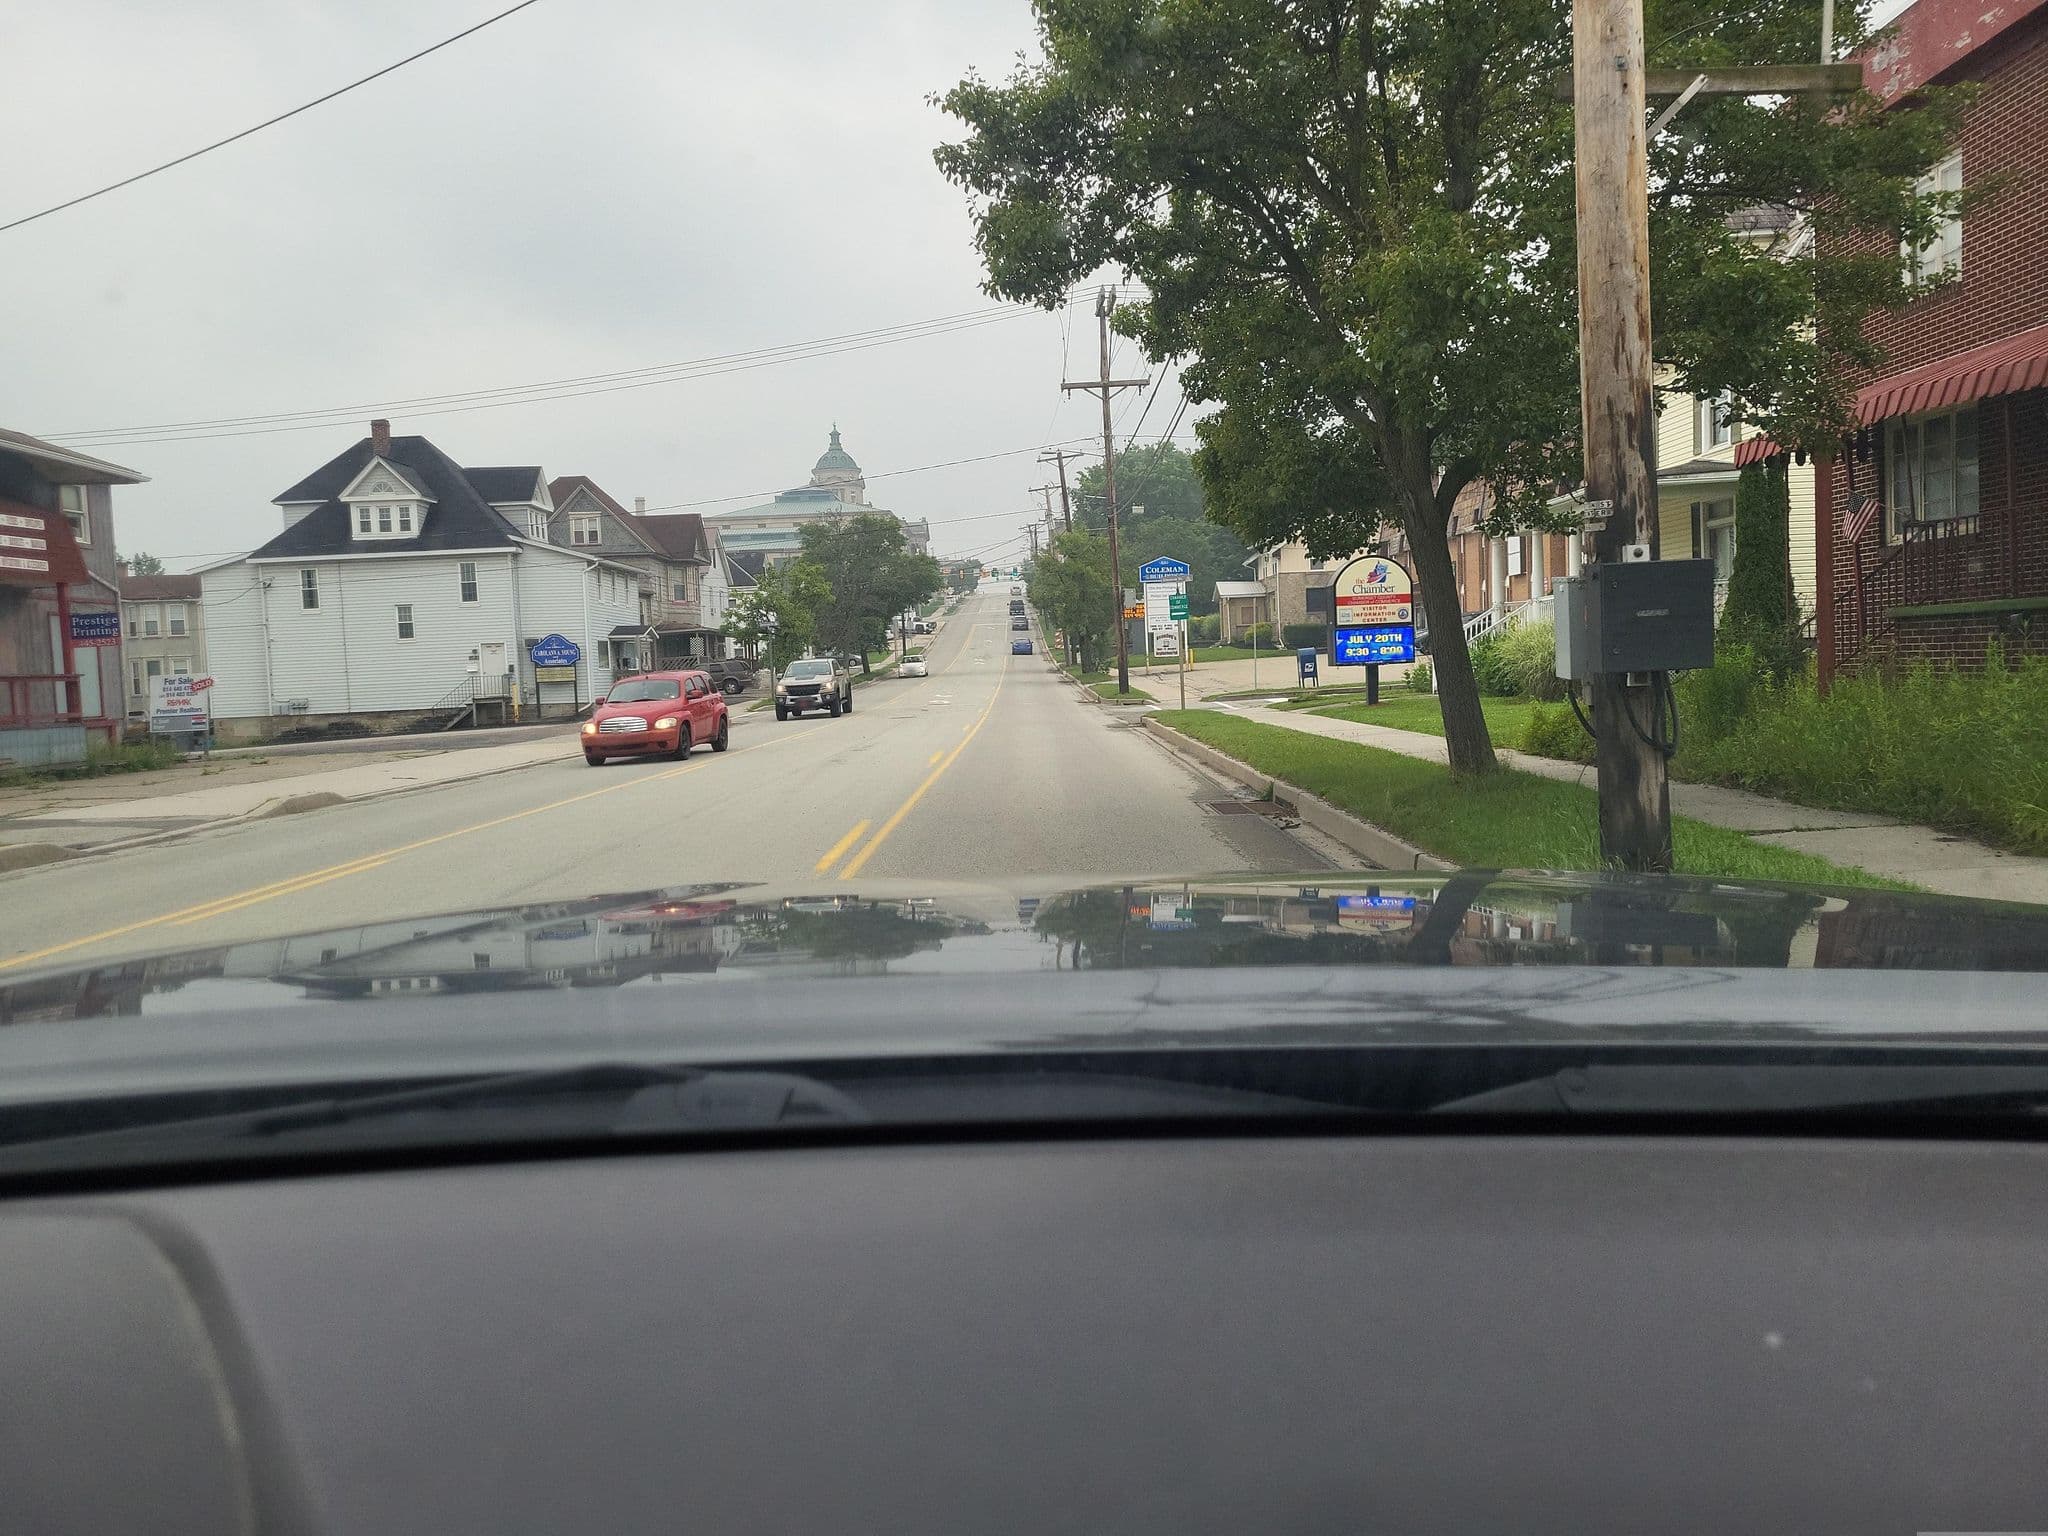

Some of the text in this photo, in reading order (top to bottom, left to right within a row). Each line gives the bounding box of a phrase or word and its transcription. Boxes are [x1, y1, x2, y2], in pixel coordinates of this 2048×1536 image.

[1145, 566, 1184, 574] COLEMAN
[1352, 584, 1396, 595] Chamber
[72, 616, 119, 627] Prestige
[72, 627, 119, 637] Printing
[1347, 633, 1402, 644] JULY 20TH
[1345, 647, 1369, 656] 9:30
[164, 676, 194, 685] For Sale
[191, 678, 214, 691] SOLD
